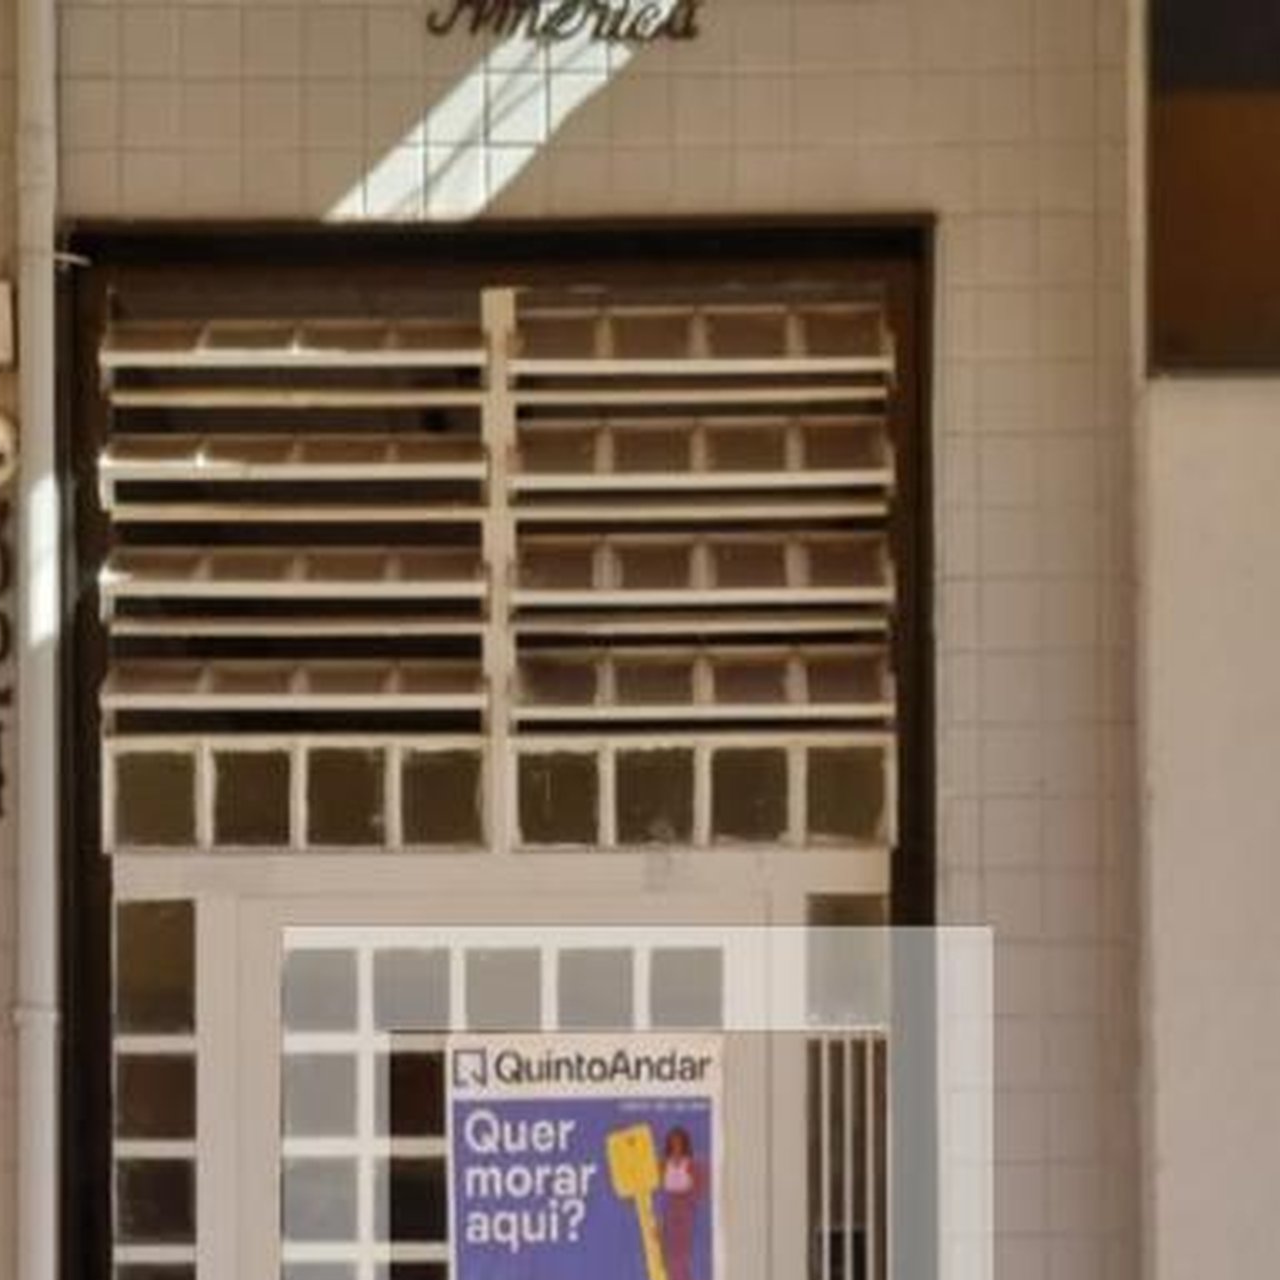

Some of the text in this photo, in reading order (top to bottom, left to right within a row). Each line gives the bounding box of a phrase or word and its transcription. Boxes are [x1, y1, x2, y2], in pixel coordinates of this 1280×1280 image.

[494, 1049, 713, 1085] QuintoAndar
[464, 1109, 576, 1154] Quer
[465, 1163, 598, 1199] morar
[466, 1199, 586, 1254] aqui?
